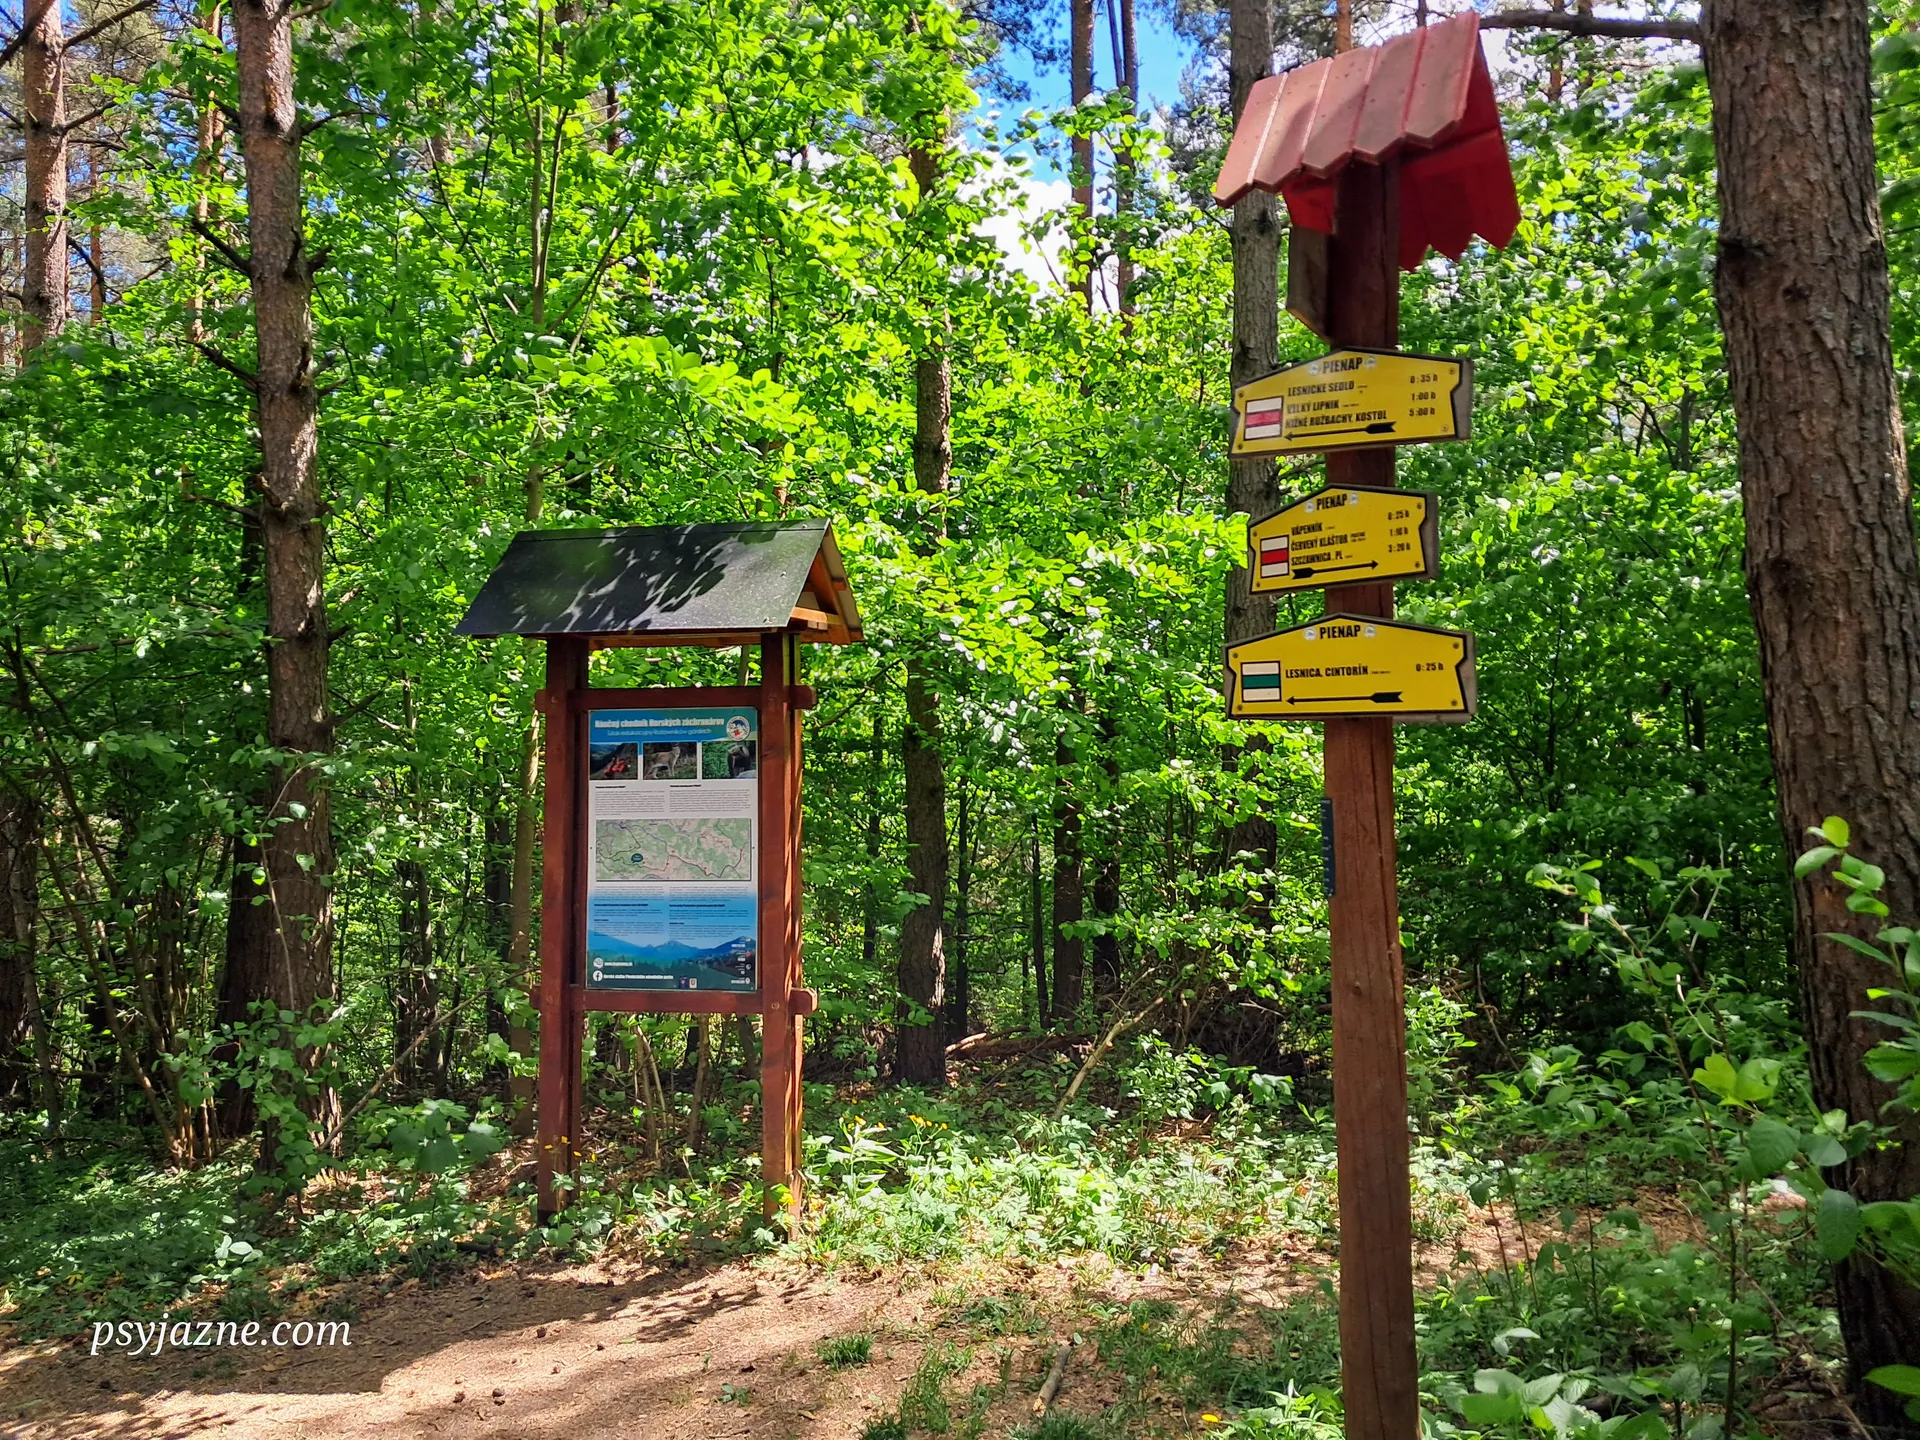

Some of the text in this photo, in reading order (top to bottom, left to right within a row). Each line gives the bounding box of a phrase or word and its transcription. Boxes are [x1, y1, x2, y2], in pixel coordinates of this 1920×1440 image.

[1322, 356, 1363, 374] PIENAP
[1328, 379, 1355, 393] SEDLO
[1355, 409, 1387, 422] KOSTOL
[1316, 493, 1348, 511] PIENAP
[1335, 549, 1343, 560] PL
[1319, 624, 1361, 640] PIENAP
[1324, 662, 1369, 677] CINTORÍN
[1437, 661, 1444, 671] h
